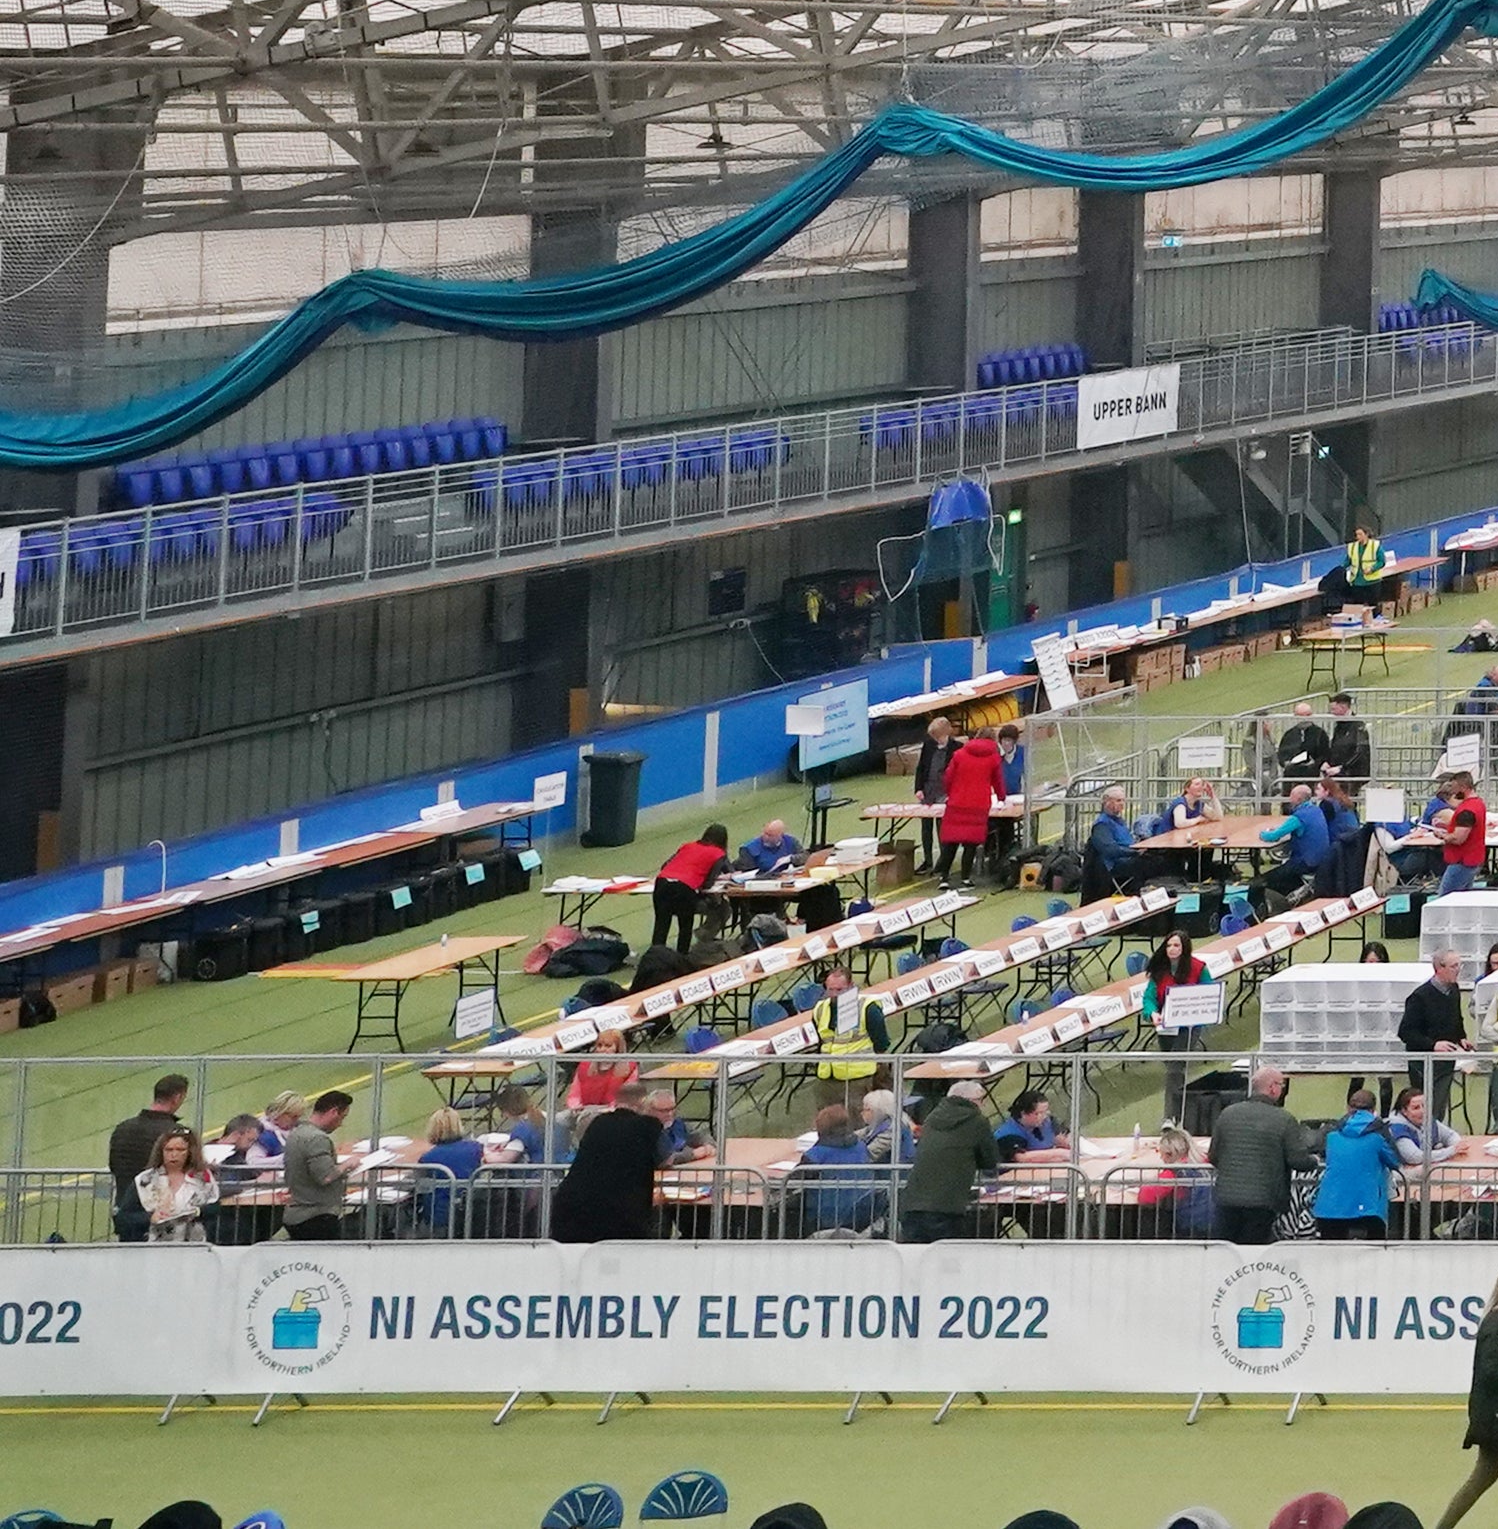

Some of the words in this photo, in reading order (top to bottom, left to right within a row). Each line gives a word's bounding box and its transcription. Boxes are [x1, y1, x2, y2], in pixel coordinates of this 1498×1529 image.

[1092, 398, 1134, 421] UPPER
[1135, 392, 1167, 415] BANN
[911, 904, 934, 922] GRANT
[936, 894, 959, 912] GRANT
[883, 915, 908, 933] GRANT
[714, 969, 743, 990] COADE
[934, 968, 961, 987] IRWIN
[682, 981, 711, 1002] COADE
[901, 982, 928, 1004] IRWIN
[646, 994, 674, 1014] COADE
[1088, 1002, 1121, 1018] MURPHY
[600, 1013, 629, 1030] BOYLAN
[560, 1025, 595, 1046] BOYLAN
[775, 1031, 801, 1050] HENRY
[248, 1286, 262, 1308] THE
[260, 1262, 321, 1286] ELECTORAL
[324, 1272, 352, 1308] OFFICE
[1212, 1286, 1225, 1308] THE
[1223, 1262, 1284, 1286] ELECTORAL
[1287, 1272, 1315, 1308] OFFICE
[370, 1296, 413, 1339] NI
[431, 1296, 679, 1339] ASSEMBLY
[698, 1295, 920, 1339] ELECTION
[939, 1295, 1049, 1339] 2022
[1334, 1296, 1377, 1340] NI
[248, 1326, 261, 1348] FOR
[258, 1350, 317, 1376] NORTHERN
[321, 1326, 352, 1368] IRELAND
[1212, 1325, 1224, 1348] FOR
[1221, 1349, 1280, 1374] NORTHERN
[1284, 1325, 1315, 1368] IRELAND
